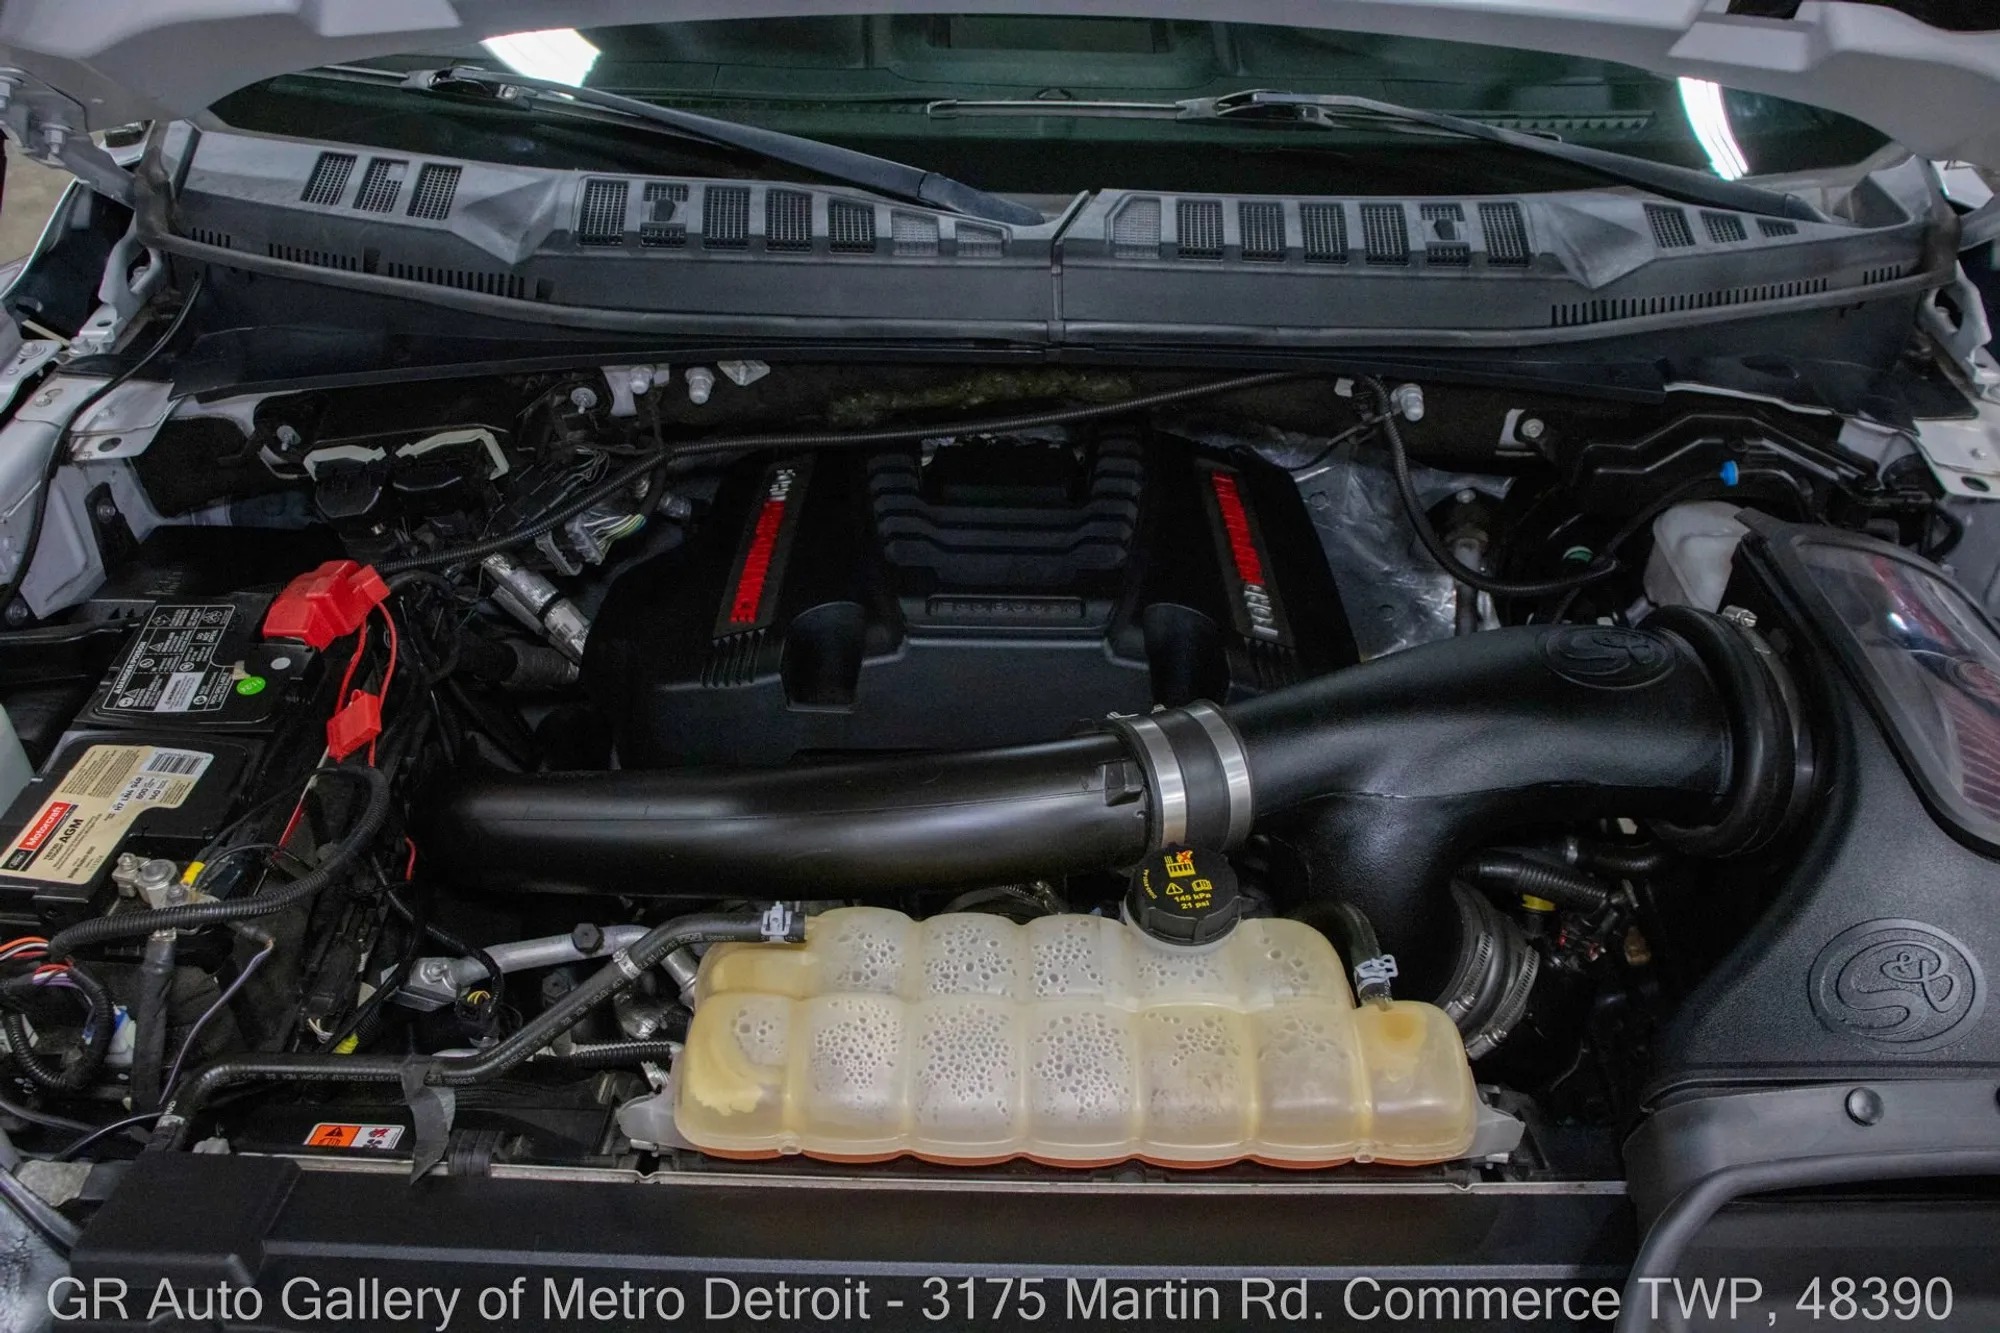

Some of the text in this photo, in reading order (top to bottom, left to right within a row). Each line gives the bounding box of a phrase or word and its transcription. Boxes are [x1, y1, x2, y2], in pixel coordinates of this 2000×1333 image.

[26, 806, 64, 846] Motorcraft
[58, 818, 84, 843] AGM
[1193, 892, 1212, 900] kPa
